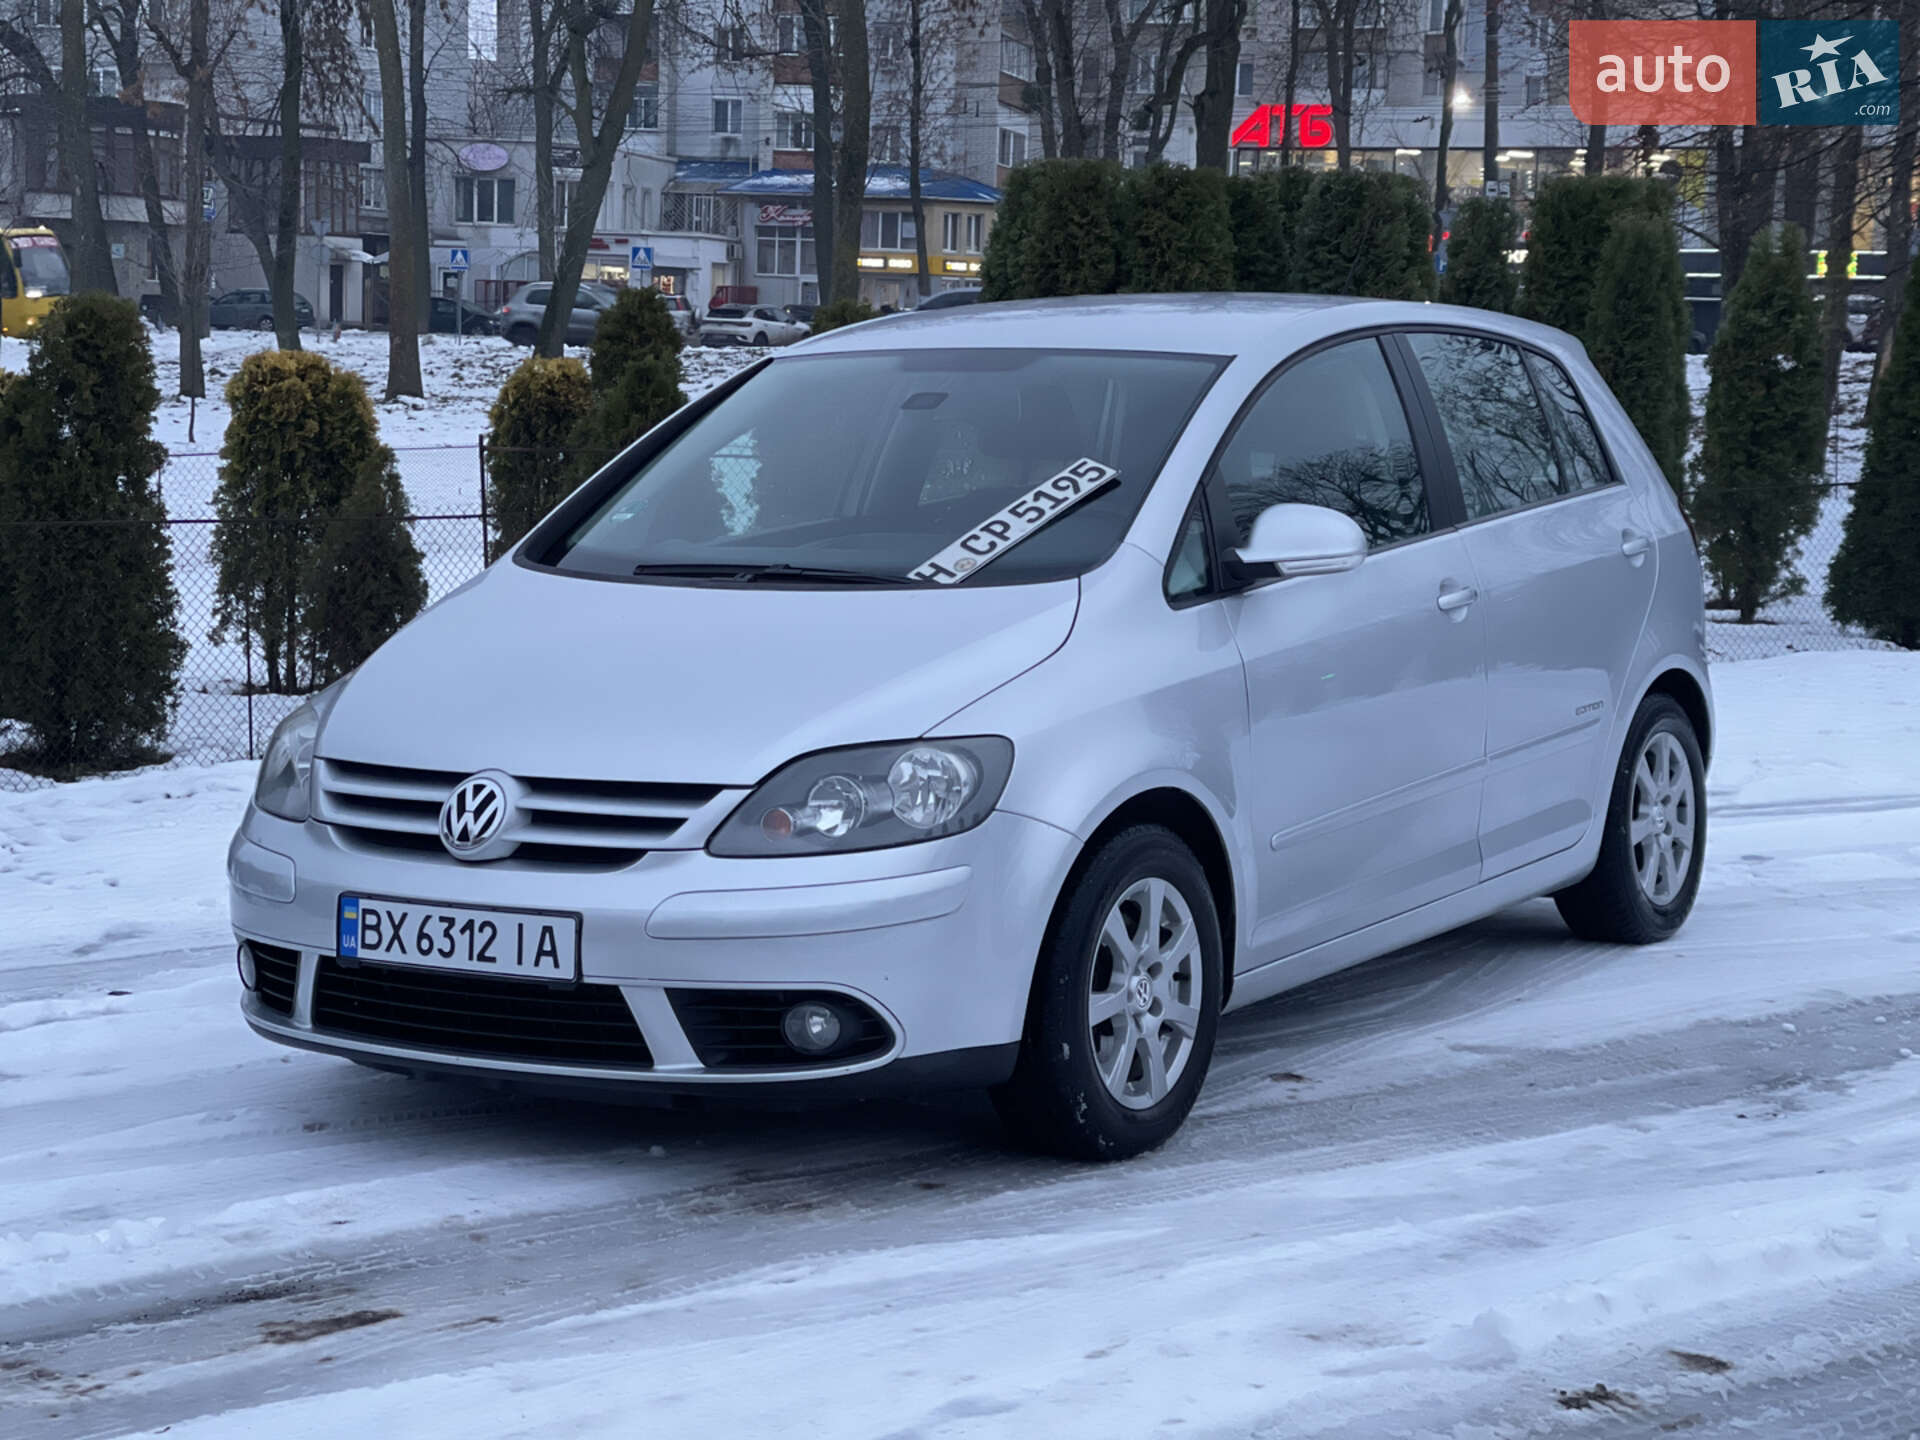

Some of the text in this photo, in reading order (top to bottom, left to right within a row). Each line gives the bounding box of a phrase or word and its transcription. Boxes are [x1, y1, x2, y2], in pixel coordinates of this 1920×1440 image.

[960, 519, 1012, 556] CP
[1008, 460, 1107, 524] 5195
[342, 934, 356, 949] UA
[360, 907, 561, 969] BX 6312 IA
